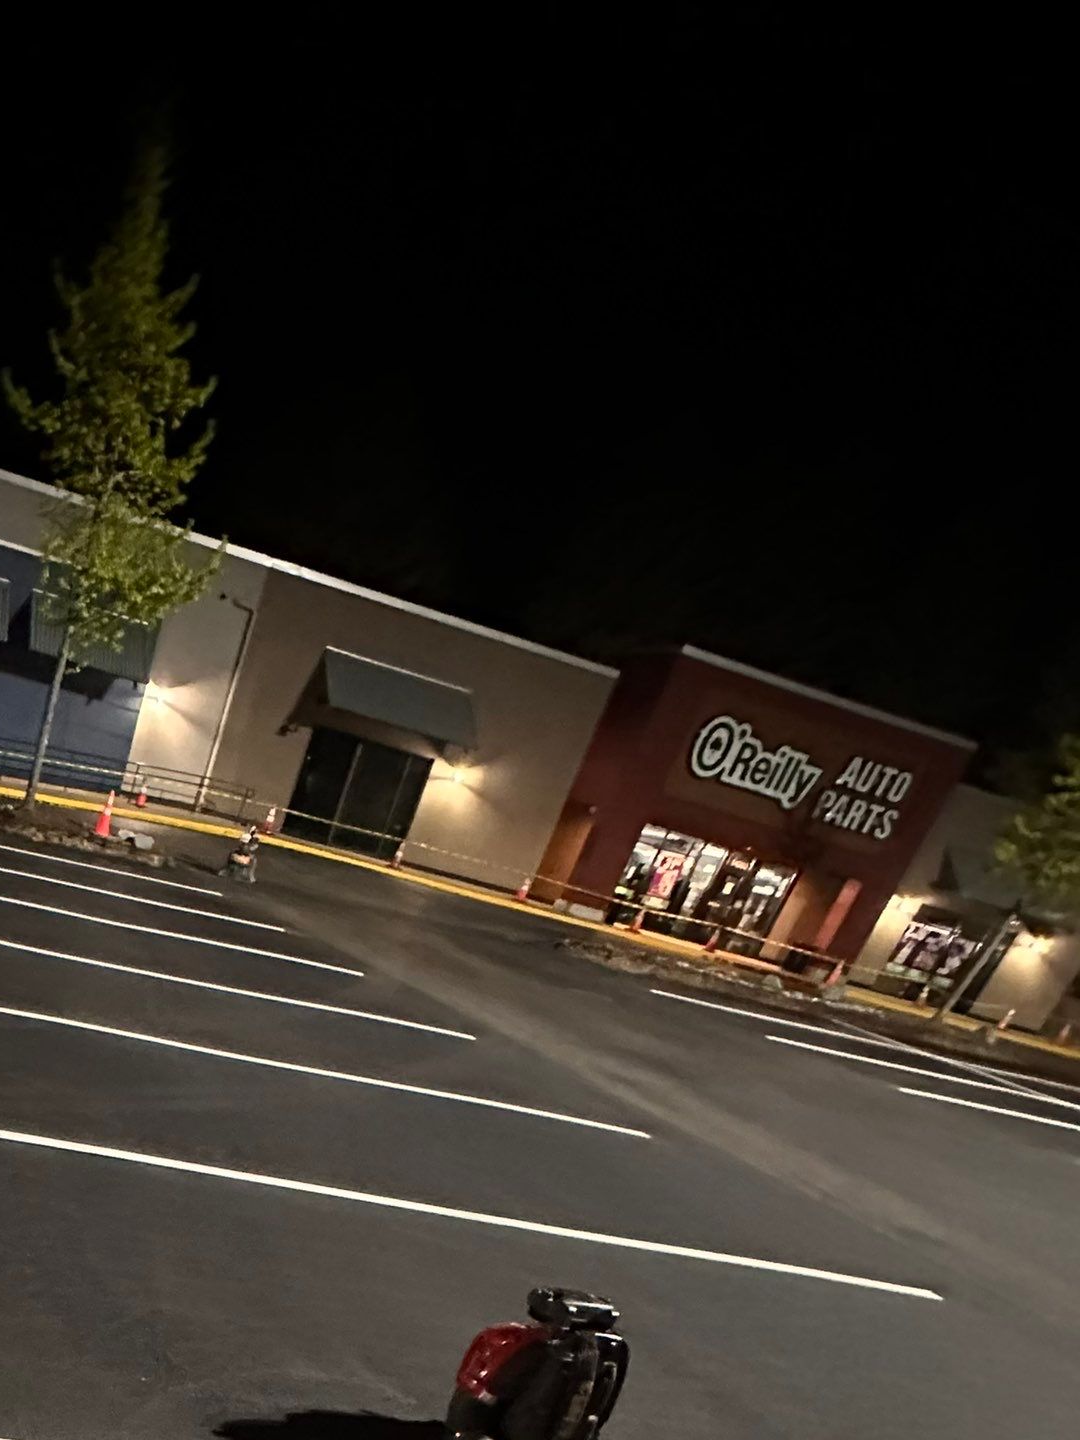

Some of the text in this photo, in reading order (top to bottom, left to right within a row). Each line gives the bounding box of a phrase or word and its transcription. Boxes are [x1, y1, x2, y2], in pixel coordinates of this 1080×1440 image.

[692, 716, 822, 808] O'Reilly
[836, 757, 913, 803] AUTO
[813, 790, 899, 839] PARTS
